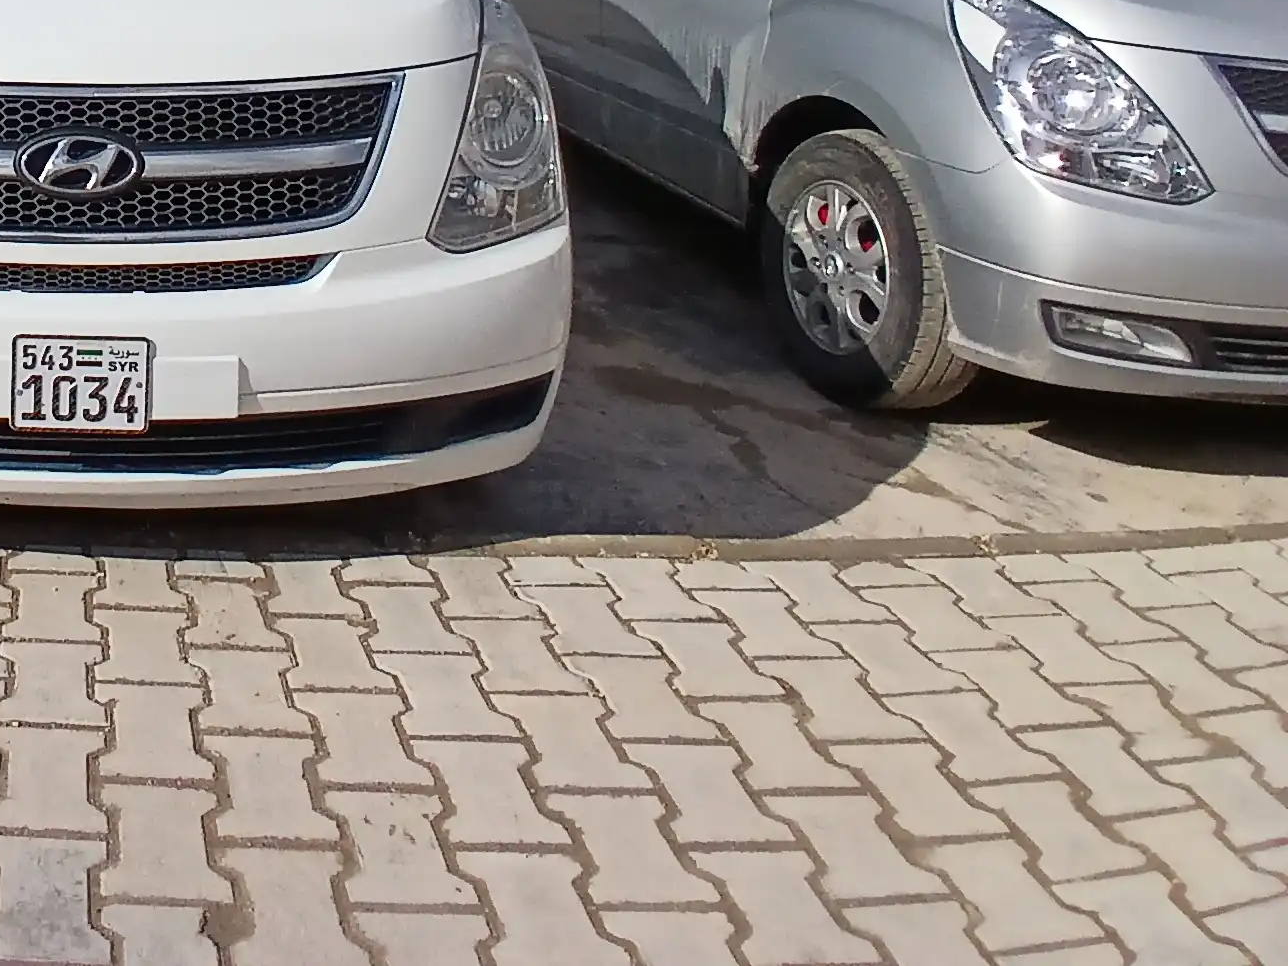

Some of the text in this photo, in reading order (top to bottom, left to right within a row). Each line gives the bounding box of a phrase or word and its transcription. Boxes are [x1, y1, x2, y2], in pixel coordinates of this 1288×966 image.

[22, 345, 74, 371] 543
[108, 346, 139, 359] سورية
[108, 361, 139, 372] SYR
[22, 375, 138, 423] 1034
